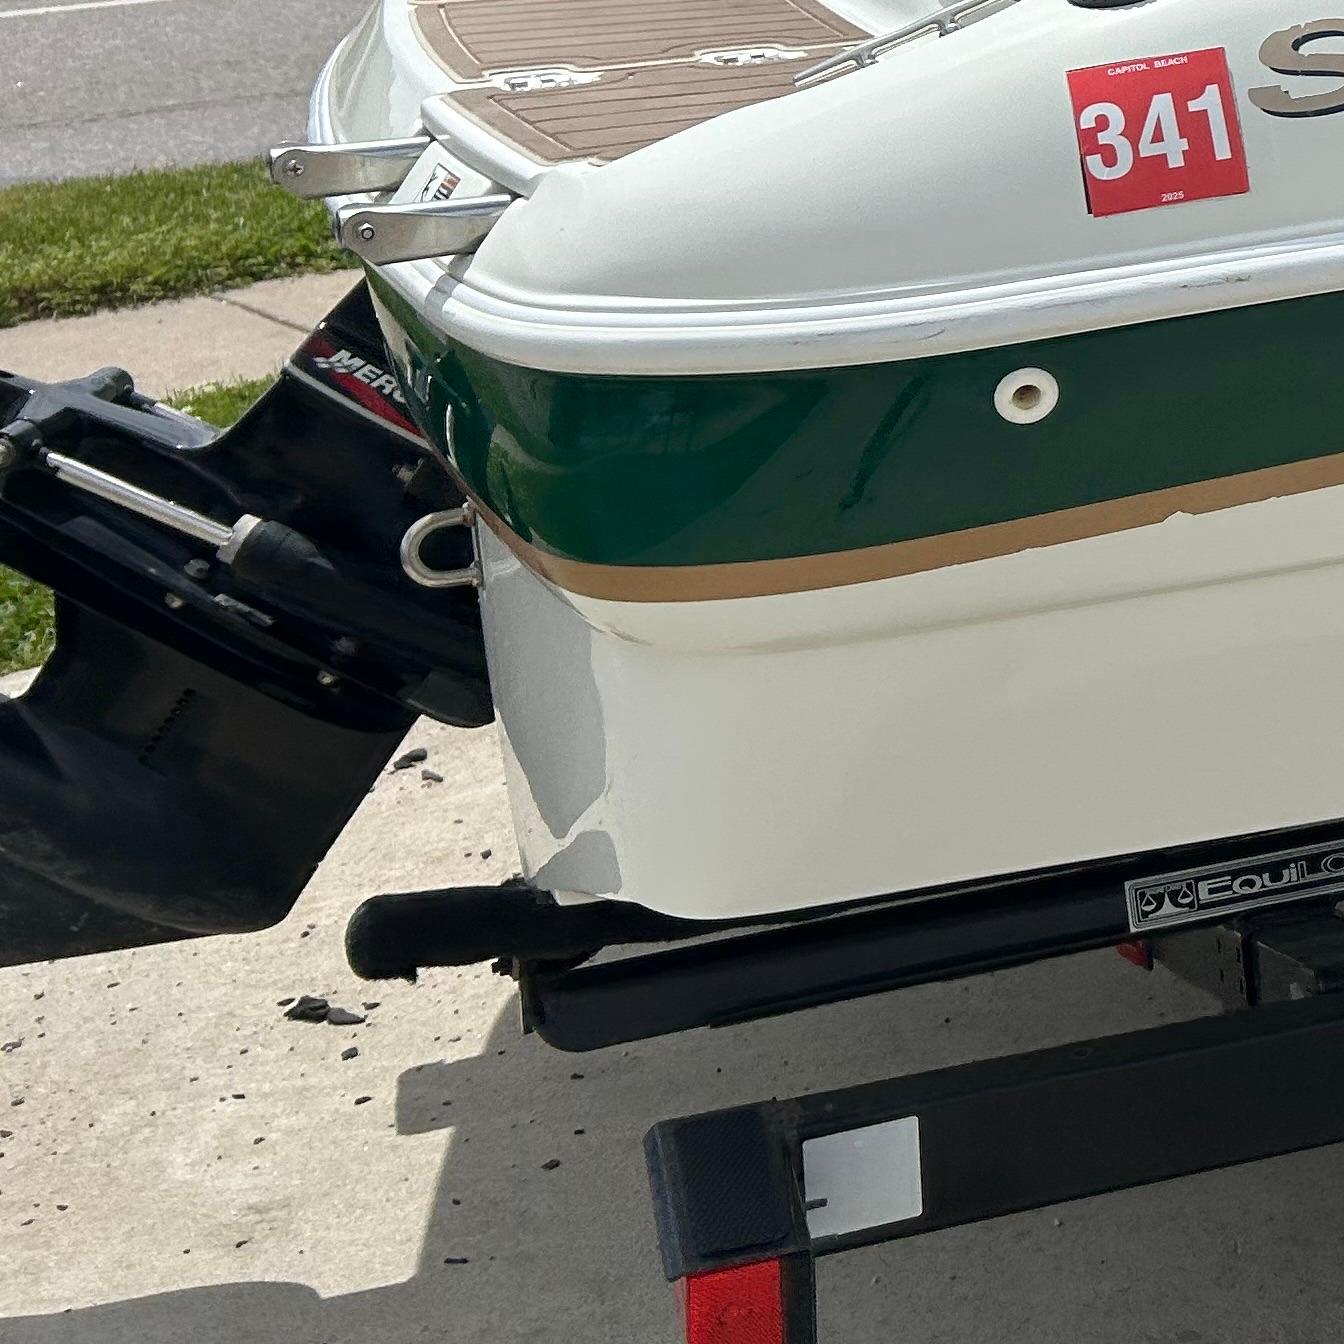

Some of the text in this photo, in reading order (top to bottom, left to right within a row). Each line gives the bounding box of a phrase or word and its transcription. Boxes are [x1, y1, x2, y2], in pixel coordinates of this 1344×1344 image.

[1106, 56, 1189, 77] CAPITOL BEACH
[1079, 82, 1233, 182] 341
[1160, 190, 1185, 203] 2025
